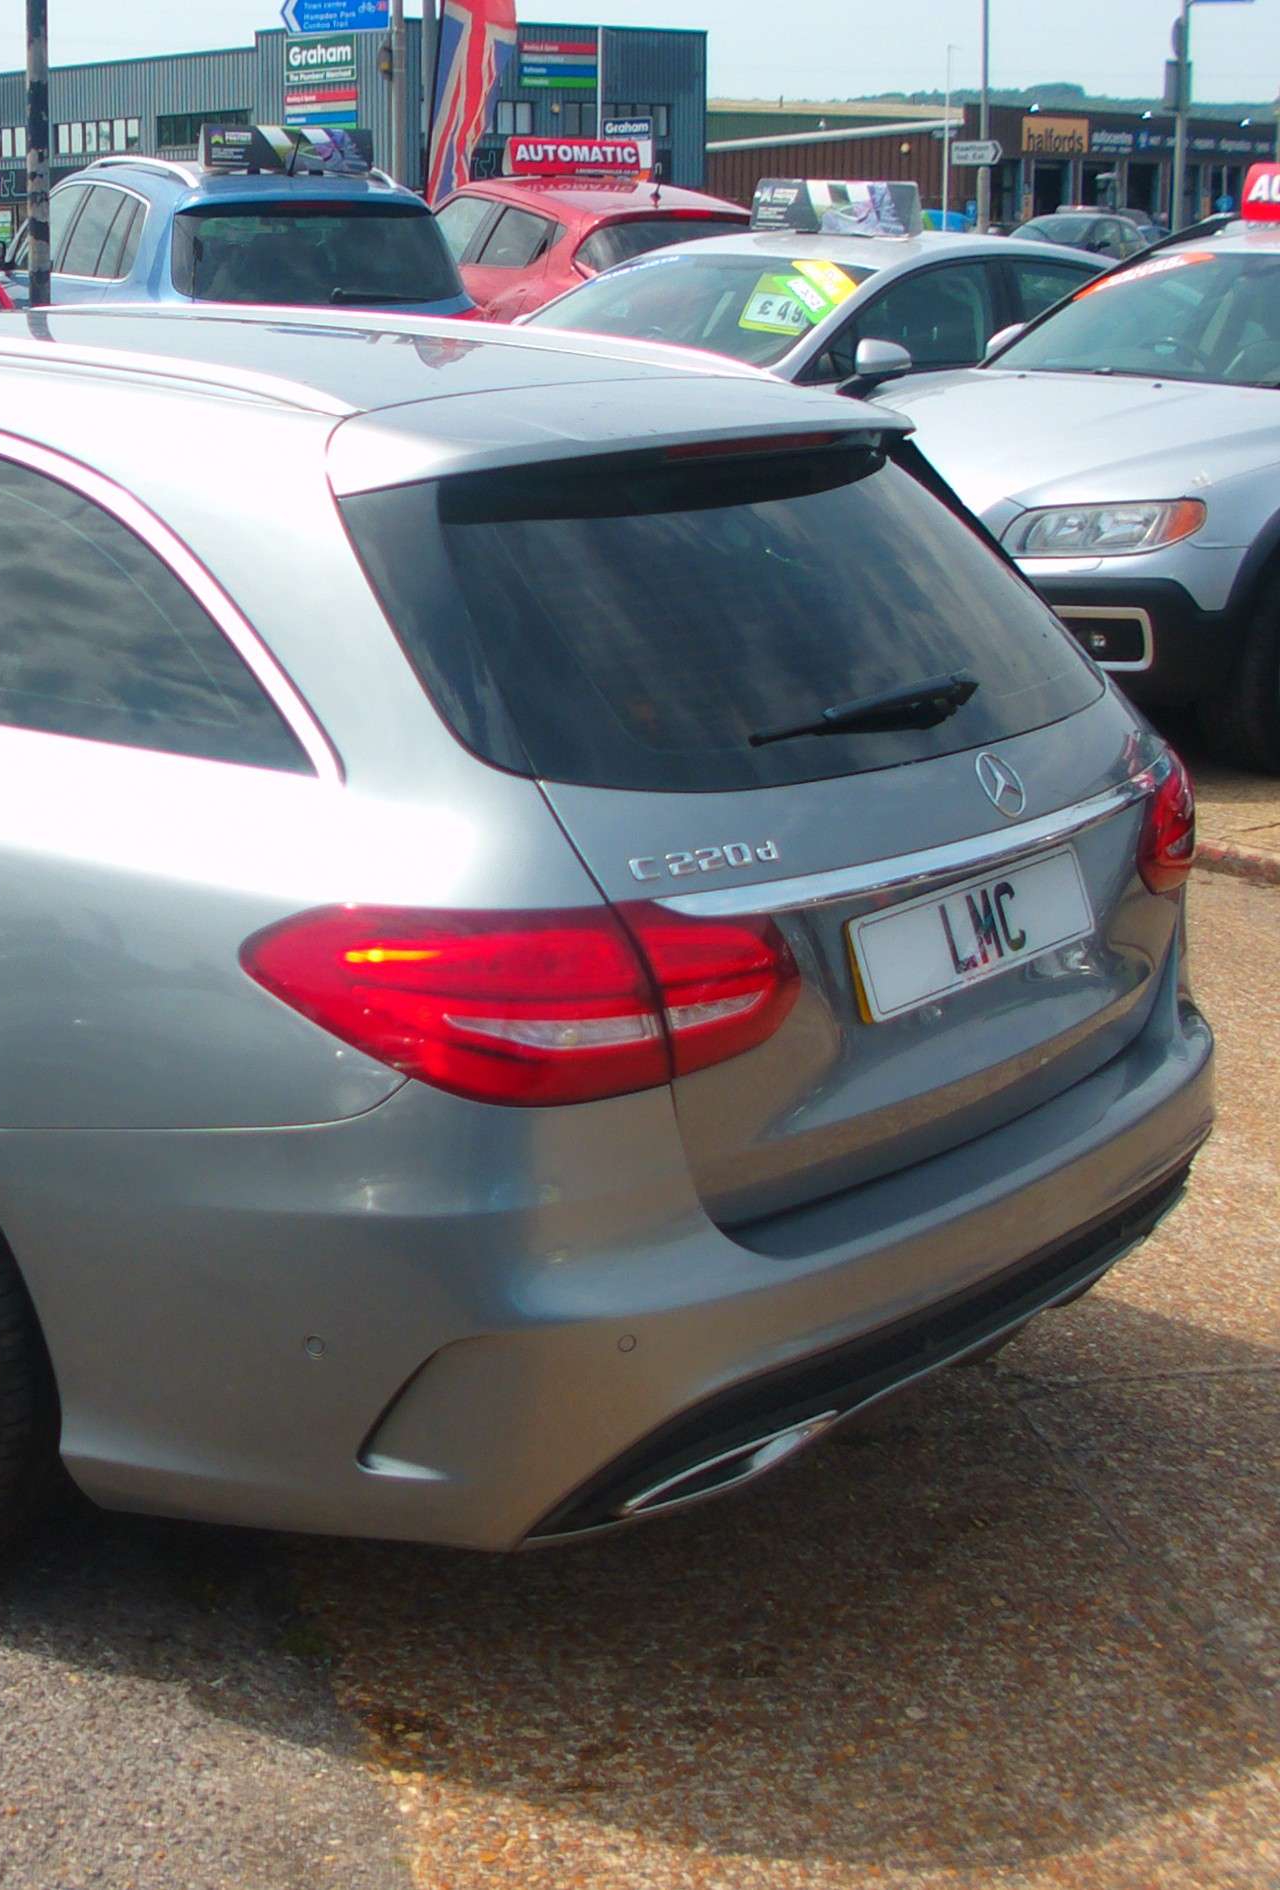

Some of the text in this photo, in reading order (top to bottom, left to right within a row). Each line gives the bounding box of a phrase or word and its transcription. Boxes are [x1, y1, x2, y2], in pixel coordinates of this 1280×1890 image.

[339, 11, 356, 19] Park
[288, 43, 352, 67] Graham
[604, 121, 649, 134] Graham
[1027, 127, 1084, 152] halfords
[515, 143, 637, 164] AUTOMATIC
[628, 840, 780, 881] C 220 d
[938, 881, 1027, 975] LMC
